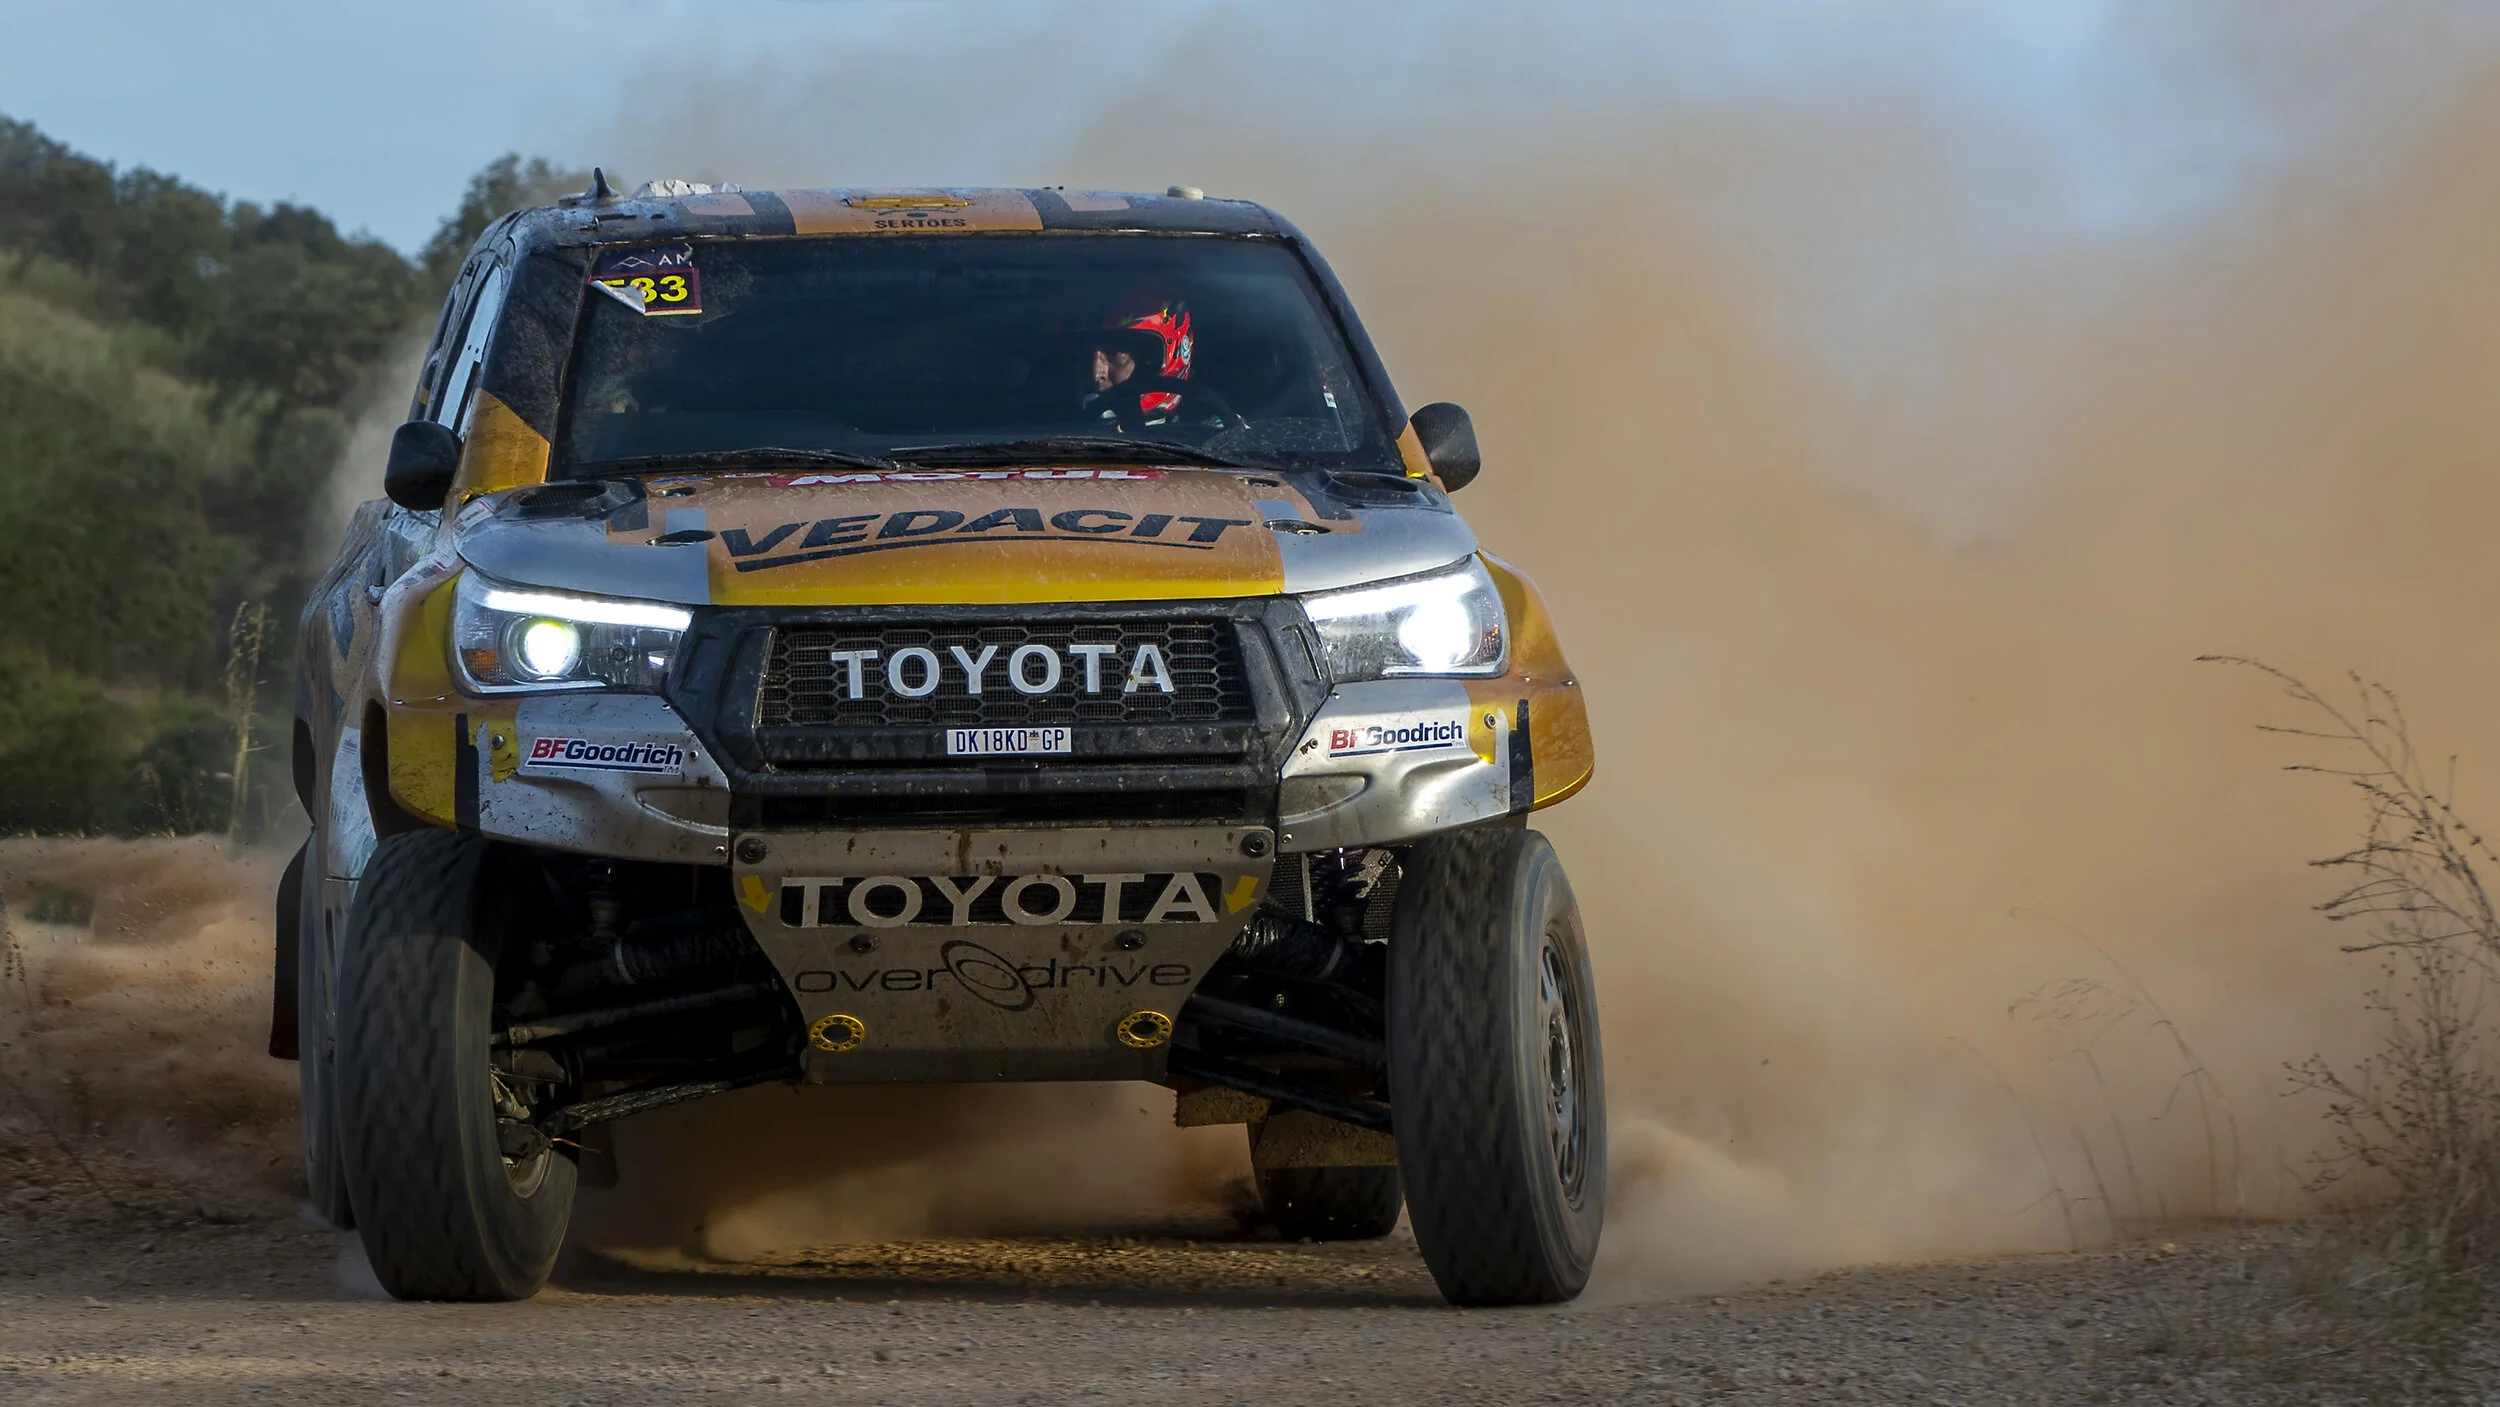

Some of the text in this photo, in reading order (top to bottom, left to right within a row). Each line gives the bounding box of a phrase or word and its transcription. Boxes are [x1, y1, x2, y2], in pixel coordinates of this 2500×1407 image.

[788, 470, 1148, 486] MOTUL
[720, 508, 1251, 557] VEDACIT
[831, 644, 1175, 699] TOYOTA
[1042, 729, 1065, 751] GP
[1330, 720, 1463, 750] BFGoodrich
[530, 738, 683, 766] BFGoodrich
[782, 872, 1220, 928] TOYOTA
